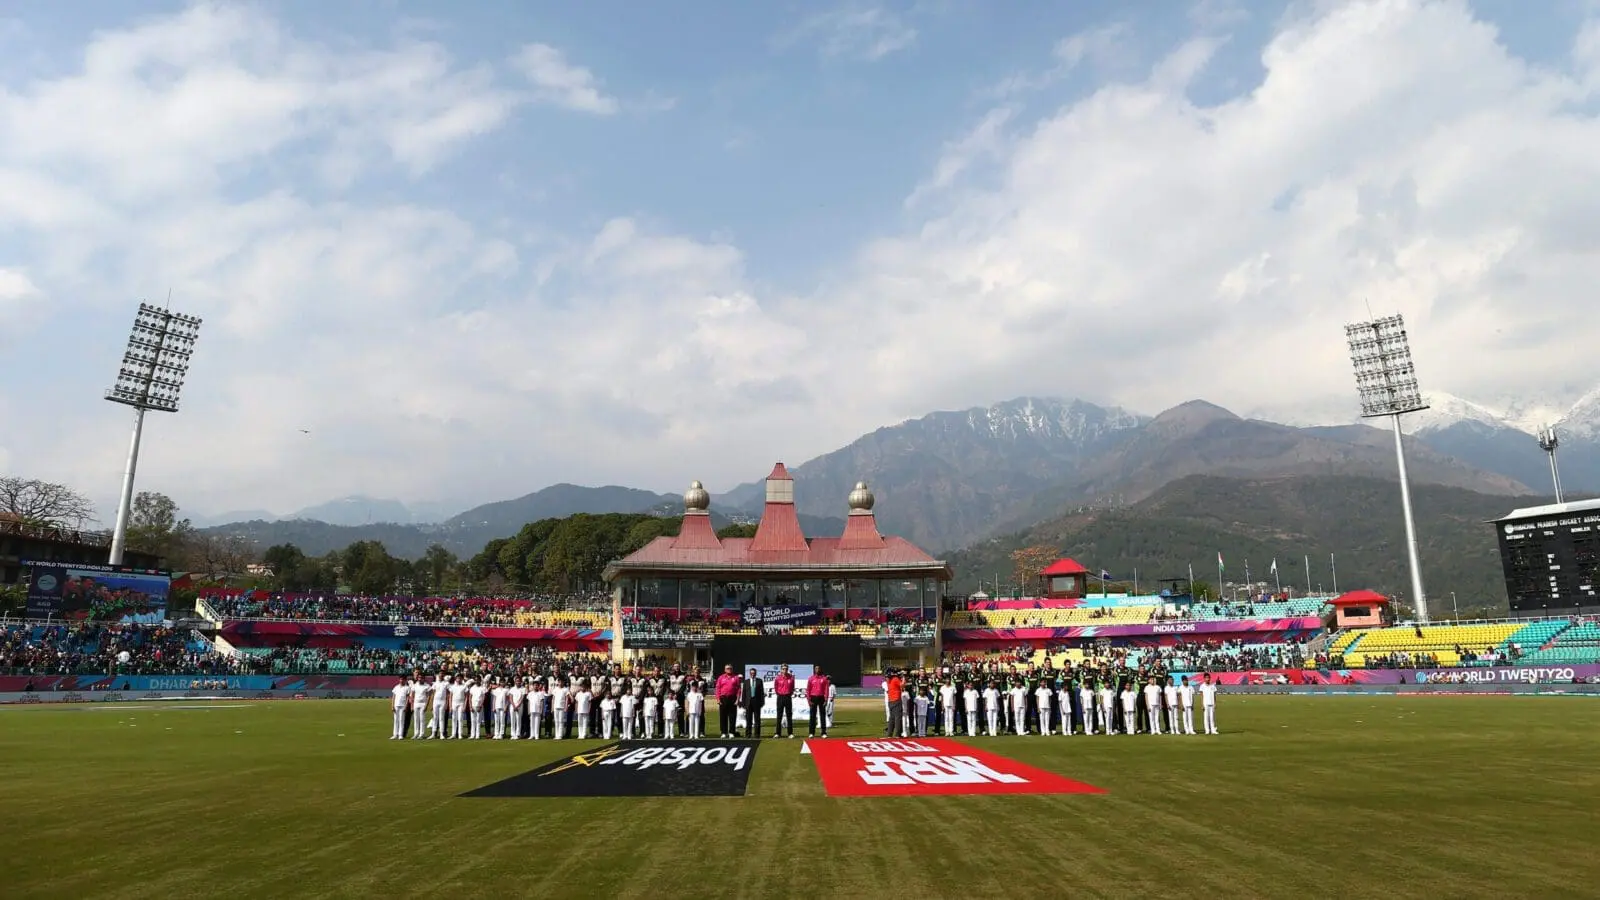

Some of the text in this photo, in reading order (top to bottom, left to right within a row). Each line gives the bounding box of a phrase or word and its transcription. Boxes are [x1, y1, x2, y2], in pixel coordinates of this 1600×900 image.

[763, 607, 791, 618] WORLD
[763, 614, 791, 622] TWENTY20
[1153, 623, 1196, 632] INDIA 2016
[1448, 670, 1496, 682] WORLD
[1500, 667, 1575, 680] TWENTY20
[847, 740, 940, 753] TYRES
[600, 747, 752, 771] hotstar
[857, 755, 1031, 785] MRF
